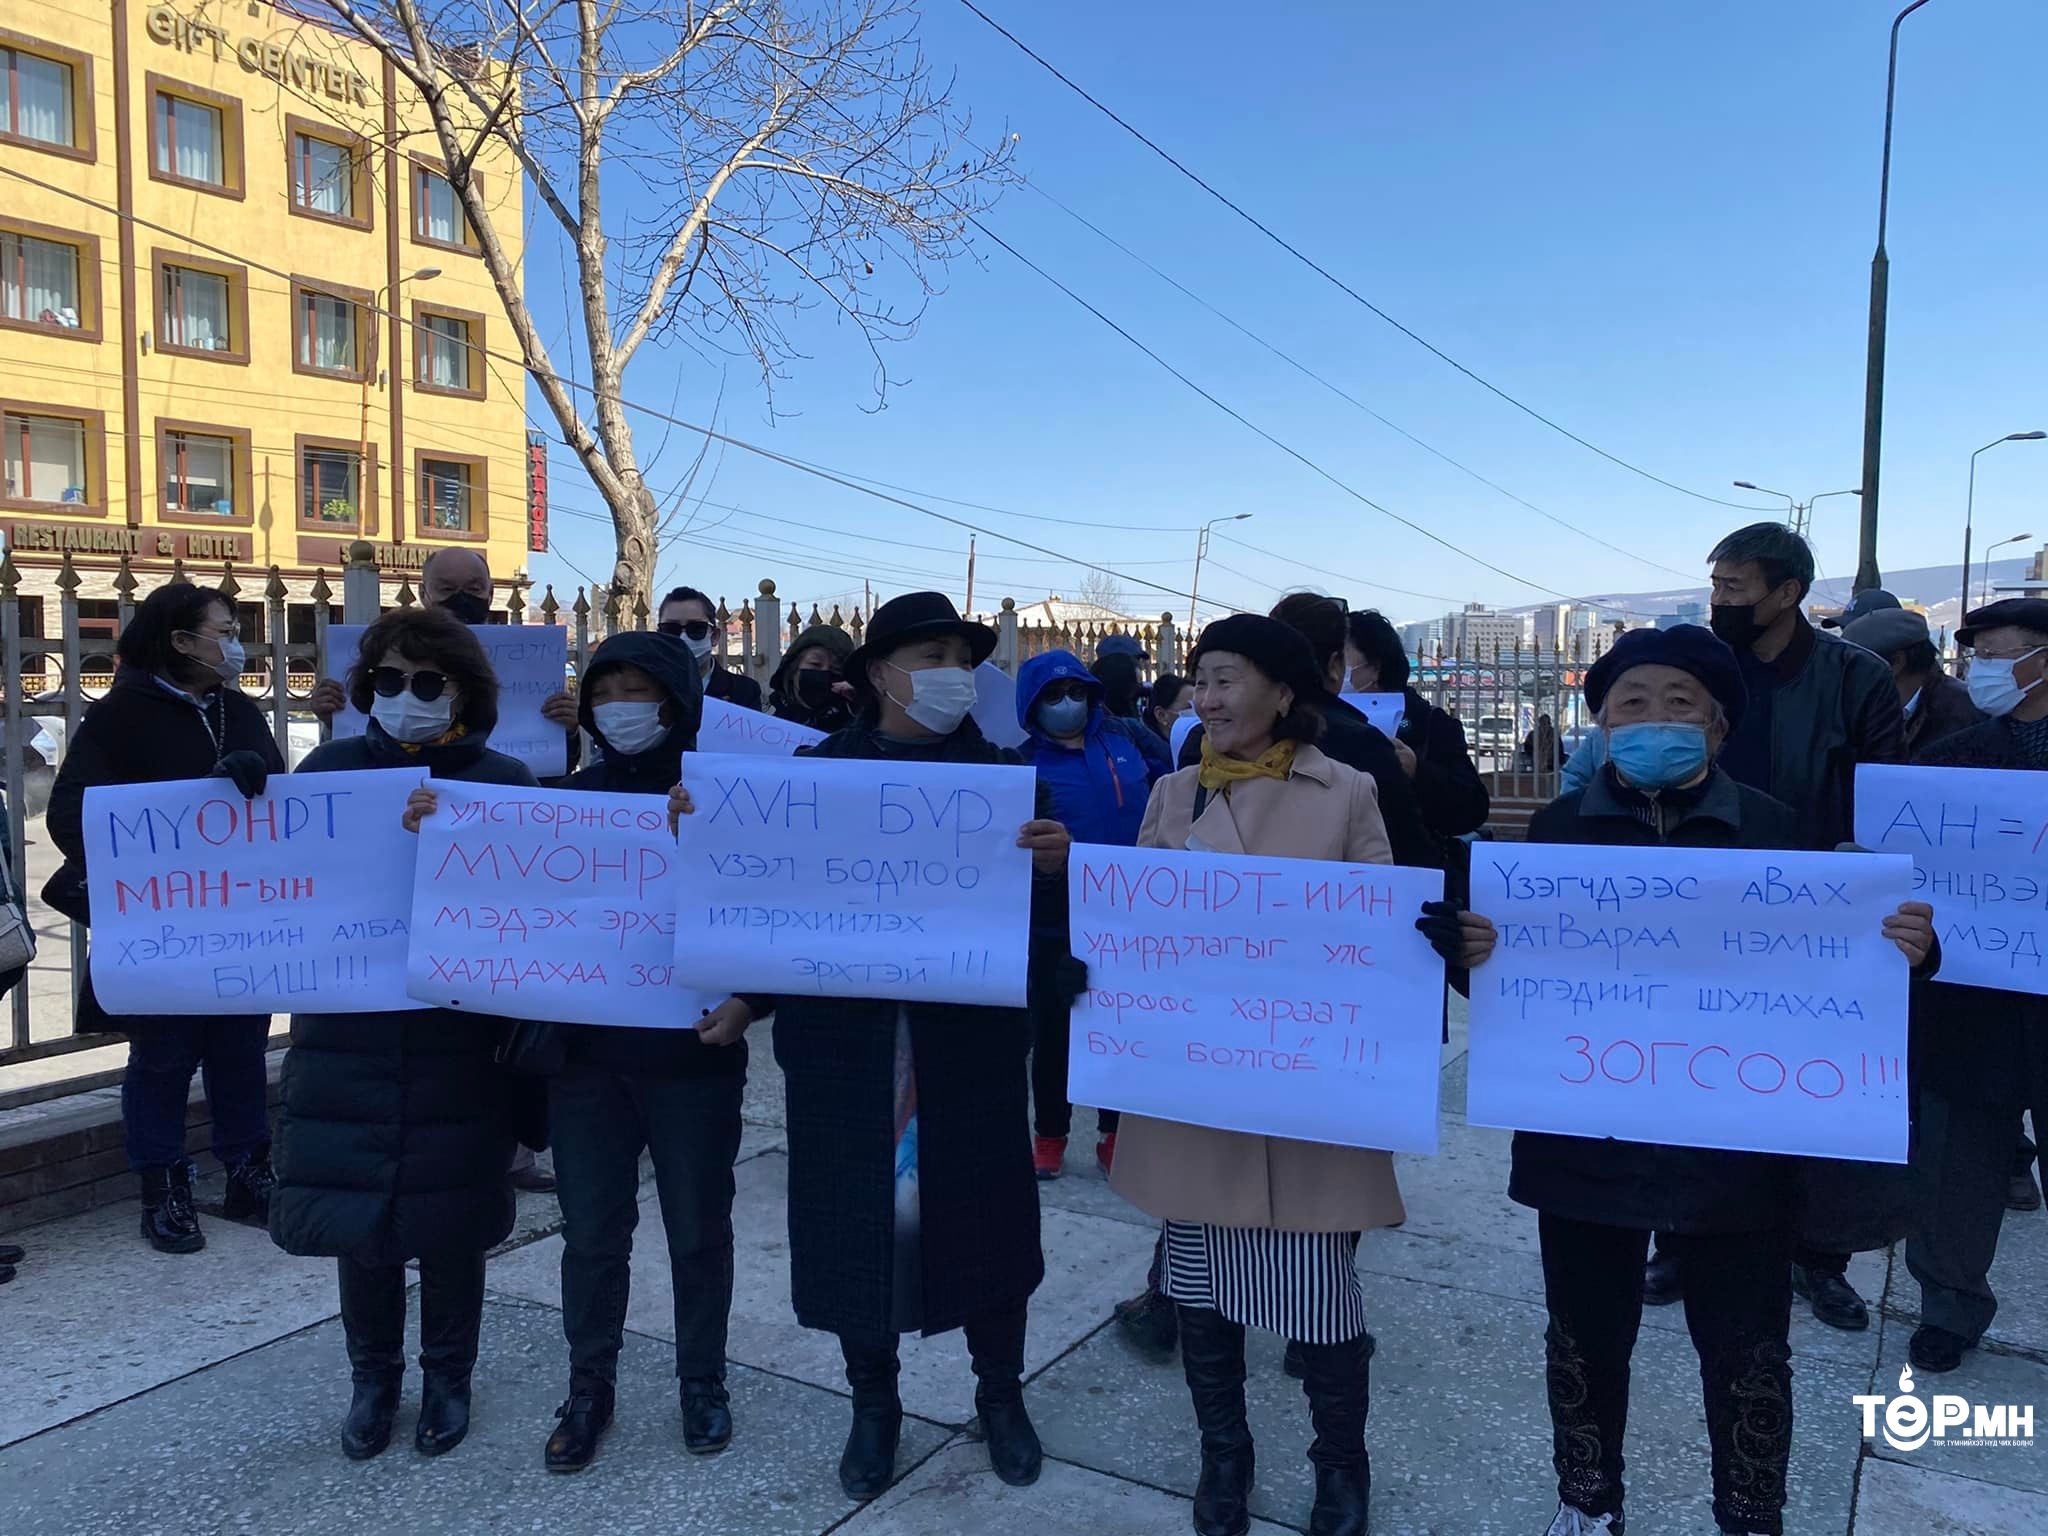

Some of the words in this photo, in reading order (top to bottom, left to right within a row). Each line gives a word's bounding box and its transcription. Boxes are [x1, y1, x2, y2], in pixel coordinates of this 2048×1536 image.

[146, 8, 229, 63] GIFT
[236, 36, 369, 109] CENTER
[12, 523, 143, 553] RESTAURANT
[157, 532, 174, 555] &
[187, 535, 241, 559] HOTEL
[450, 801, 671, 839] УЛСТӨРЖСӨ
[825, 858, 980, 902] БОДЛОО
[1740, 866, 1852, 905] АВАХ
[118, 918, 304, 967] ХЭВЛЭЛИЙН
[331, 918, 409, 942] АЛБА
[433, 906, 577, 944] МЭДЭХ
[708, 900, 925, 944] ИЛЭРХИЙЛЭХ
[1943, 922, 2042, 969] МЭД
[213, 959, 318, 999] БИШ
[427, 955, 608, 997] ХАЛДАХАА
[1499, 972, 1669, 1019] ИРГЭДИЙГ
[1698, 986, 1865, 1021] ШУЛАХАА
